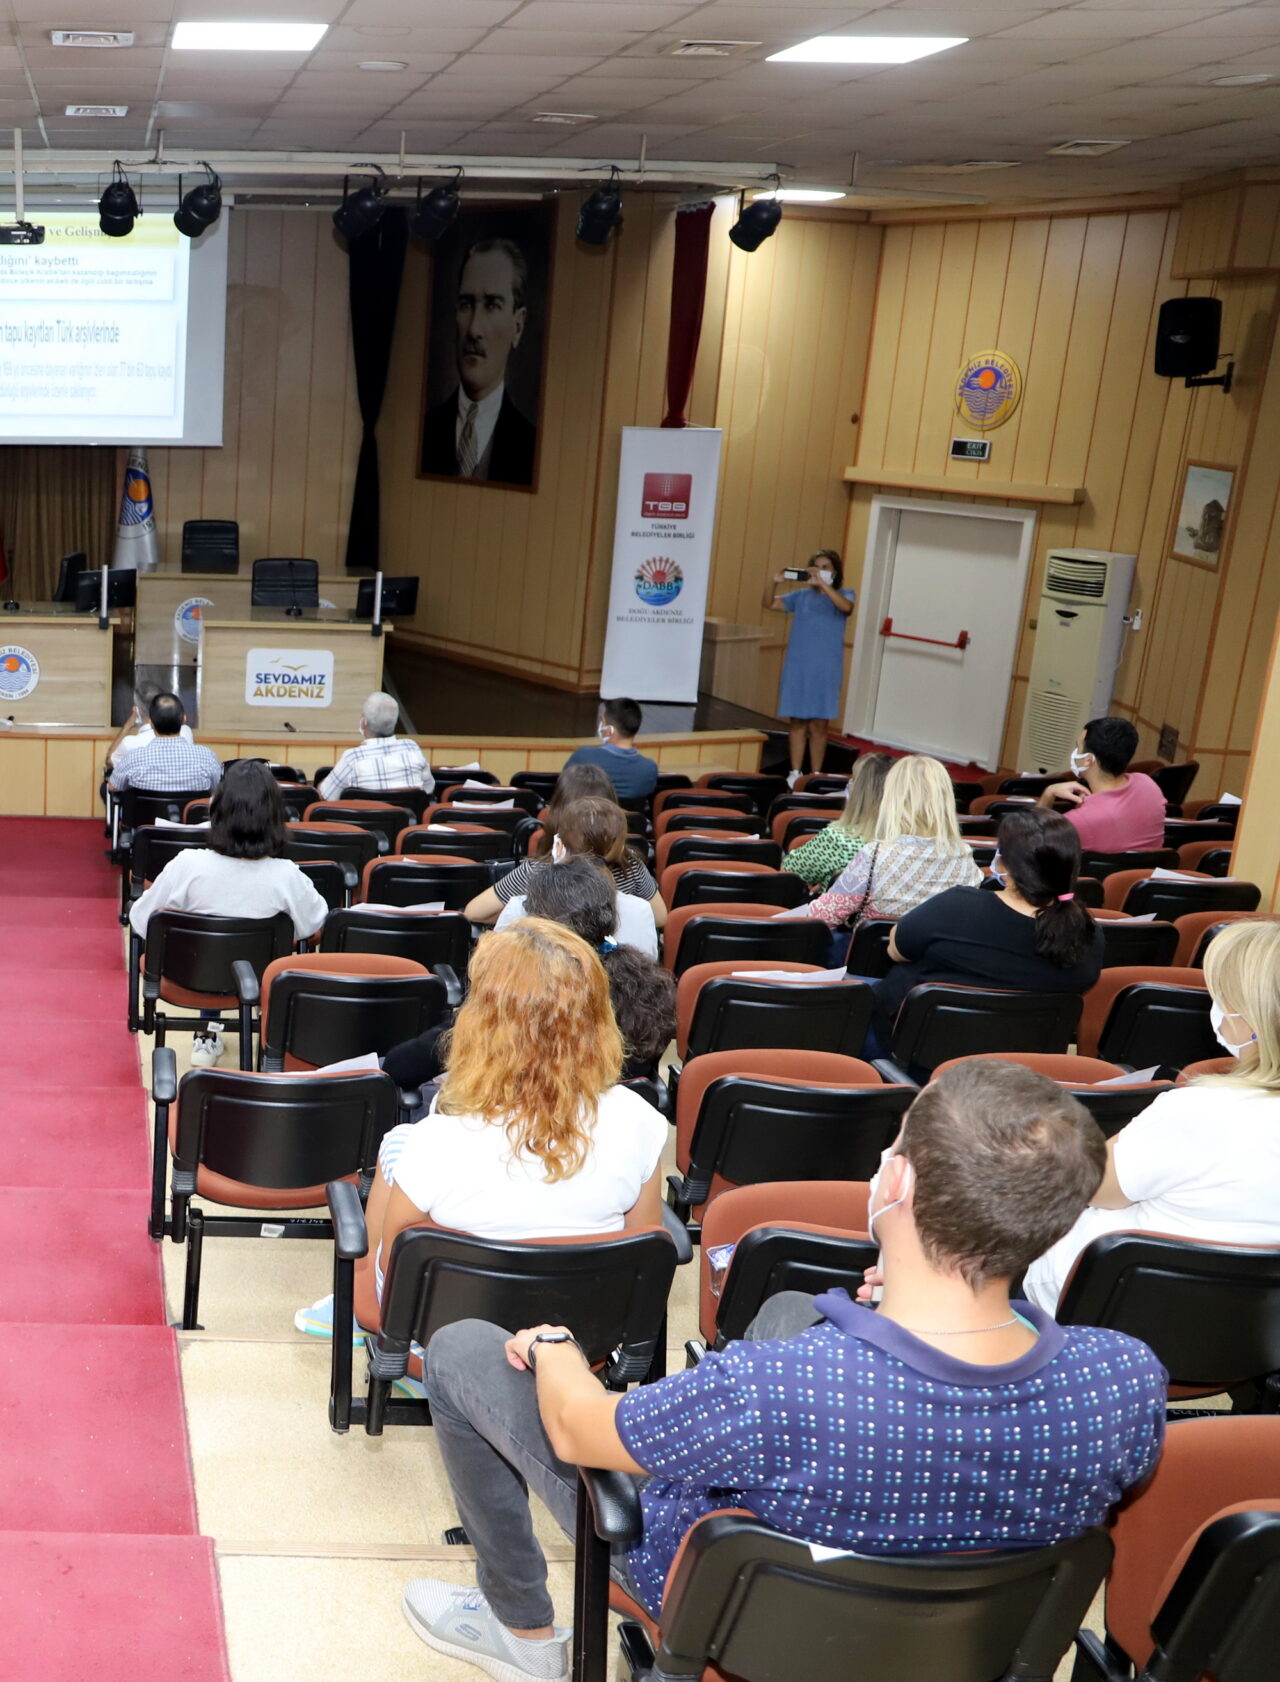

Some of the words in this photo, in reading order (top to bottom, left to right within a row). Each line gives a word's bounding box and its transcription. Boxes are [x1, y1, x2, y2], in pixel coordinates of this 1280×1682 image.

[49, 228, 63, 237] ve
[34, 255, 79, 268] kaybetti
[5, 321, 23, 349] tapu
[56, 319, 74, 343] Türk
[645, 501, 686, 511] TBB
[643, 581, 674, 591] DABB
[255, 672, 326, 685] SEVDAMIZ
[253, 685, 325, 698] AKDENİZ
